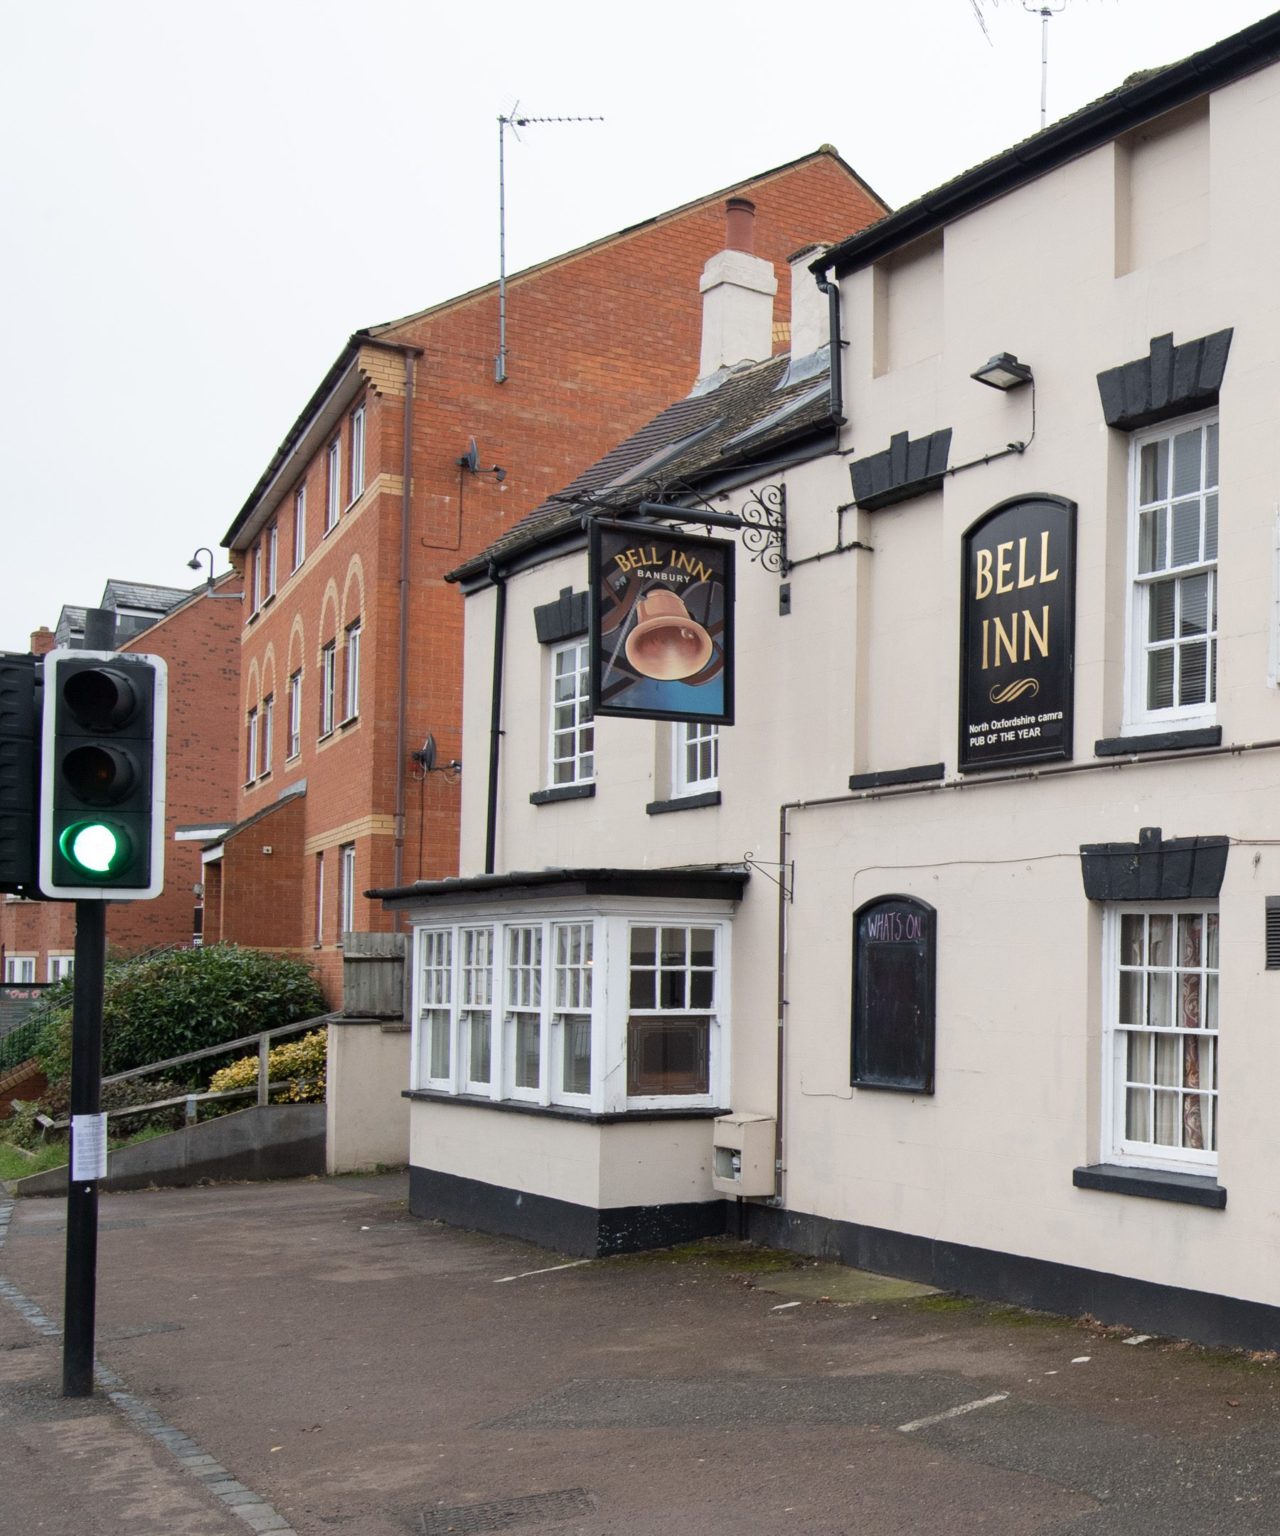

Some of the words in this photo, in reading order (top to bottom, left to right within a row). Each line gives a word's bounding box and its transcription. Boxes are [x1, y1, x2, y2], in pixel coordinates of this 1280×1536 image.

[614, 547, 663, 572] BELL
[670, 549, 713, 583] INN
[637, 569, 690, 583] BANBURY
[974, 530, 1059, 600] BELL
[981, 605, 1050, 669] INN
[969, 722, 989, 734] North
[991, 714, 1036, 730] Oxfordshire
[1038, 711, 1063, 722] camra
[970, 735, 985, 747] PUB
[987, 733, 998, 744] OF
[1000, 731, 1016, 742] THE
[1018, 727, 1041, 740] YEAR
[868, 913, 902, 941] WHATS
[906, 914, 921, 939] ON
